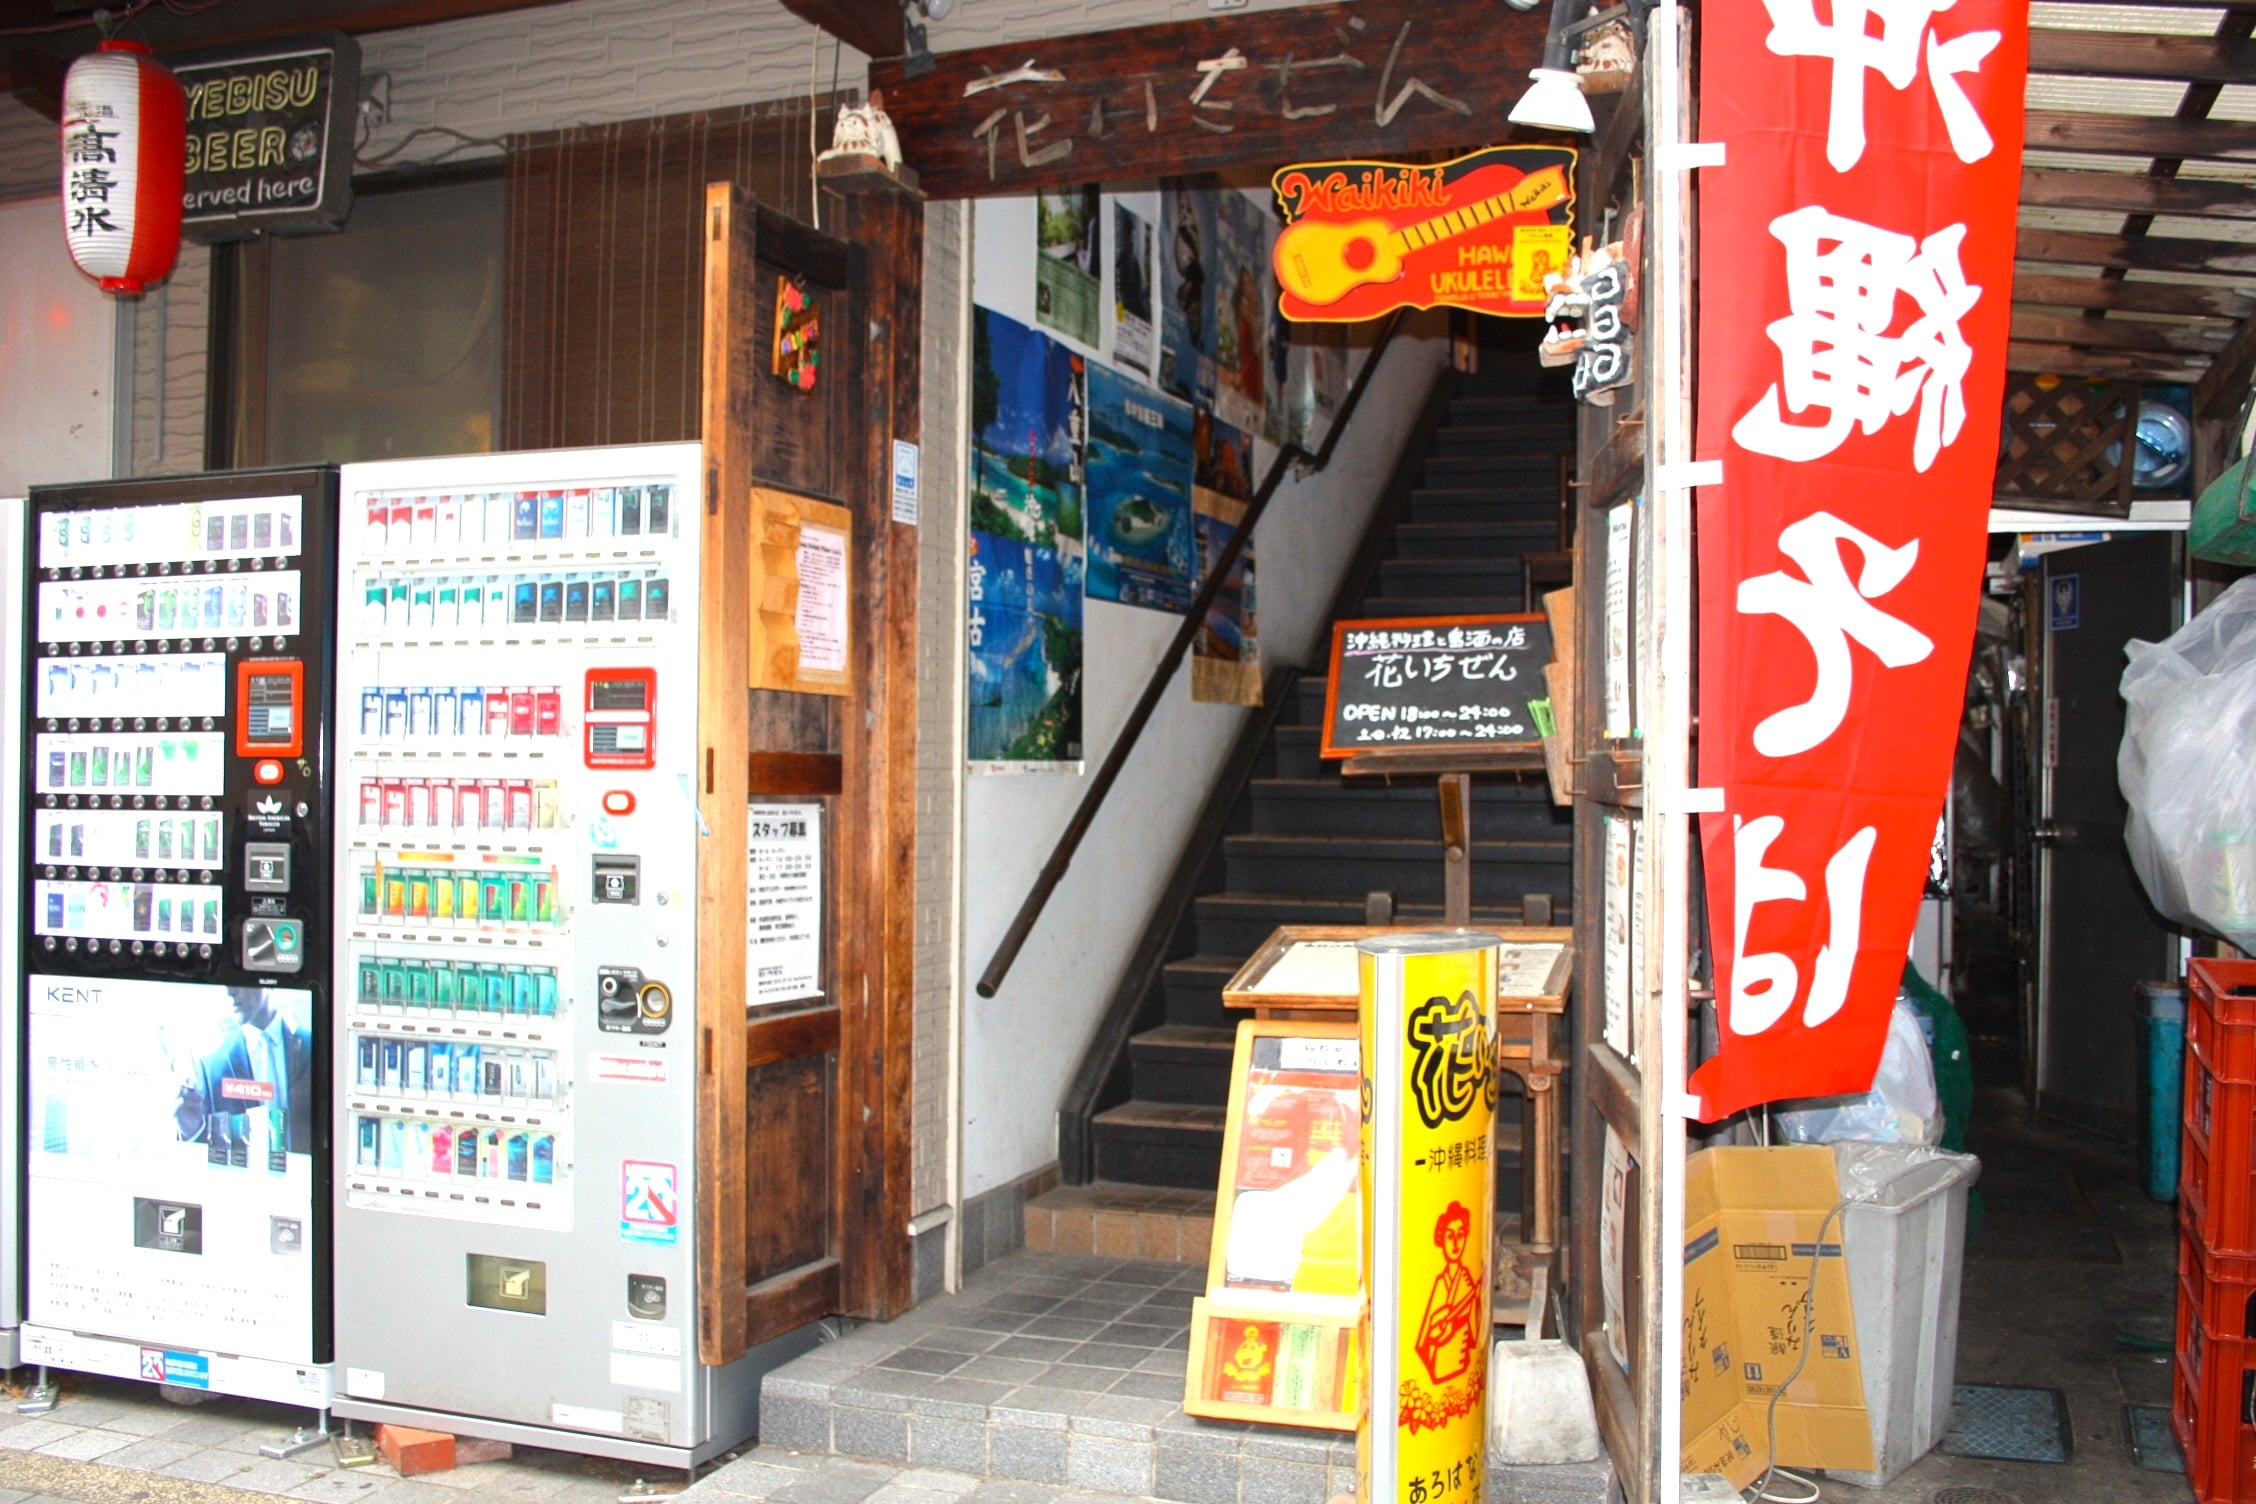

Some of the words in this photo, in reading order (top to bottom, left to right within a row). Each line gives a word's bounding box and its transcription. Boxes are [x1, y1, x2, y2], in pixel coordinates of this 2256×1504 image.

[184, 67, 318, 121] YEBISU
[184, 126, 286, 174] BEER
[183, 178, 250, 209] erved
[258, 177, 314, 203] here
[1281, 168, 1452, 213] Waikiki
[1459, 244, 1514, 267] HAW
[1346, 626, 1526, 651] 沖縄料理と島酒の店
[1364, 653, 1517, 688] 花いちぜん
[1343, 704, 1397, 722] OPEN
[47, 986, 102, 1004] KENT
